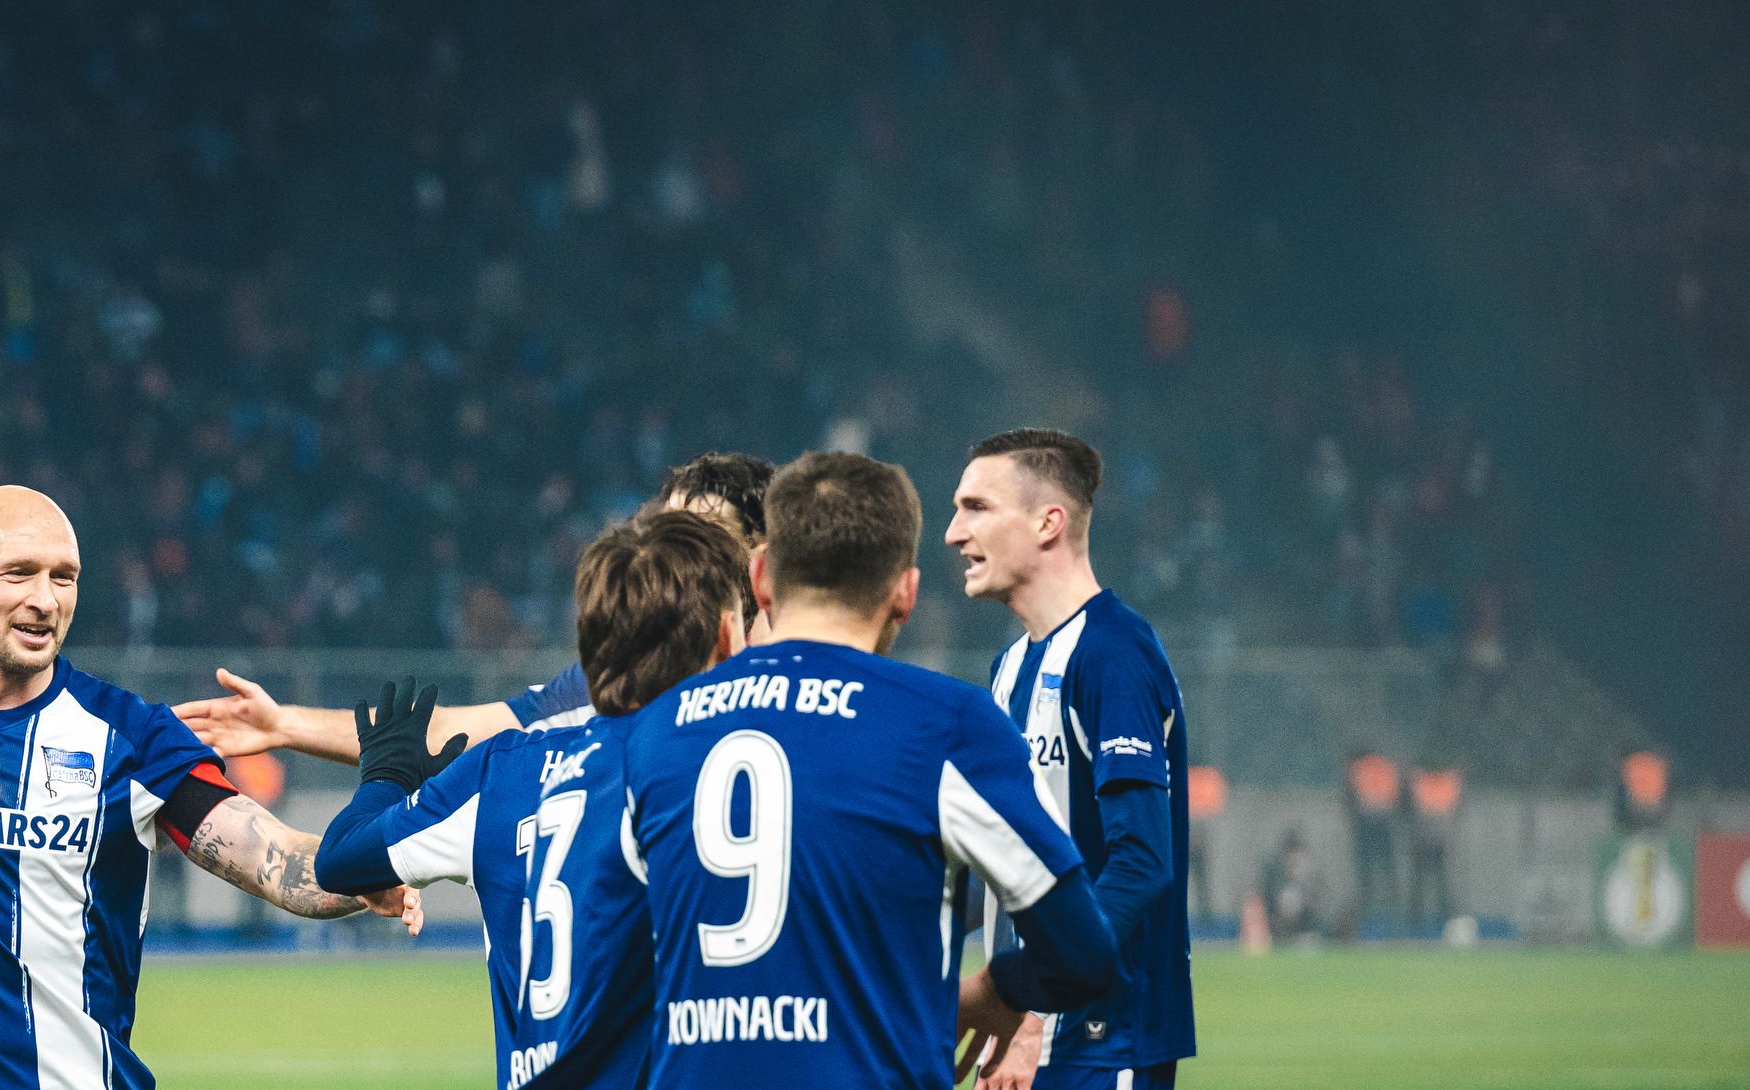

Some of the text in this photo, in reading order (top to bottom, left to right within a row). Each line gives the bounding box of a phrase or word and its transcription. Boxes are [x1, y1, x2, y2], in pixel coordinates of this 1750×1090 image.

[675, 674, 864, 727] HERTHA BSC
[692, 729, 794, 967] 9
[667, 995, 828, 1045] KOWNACKI
